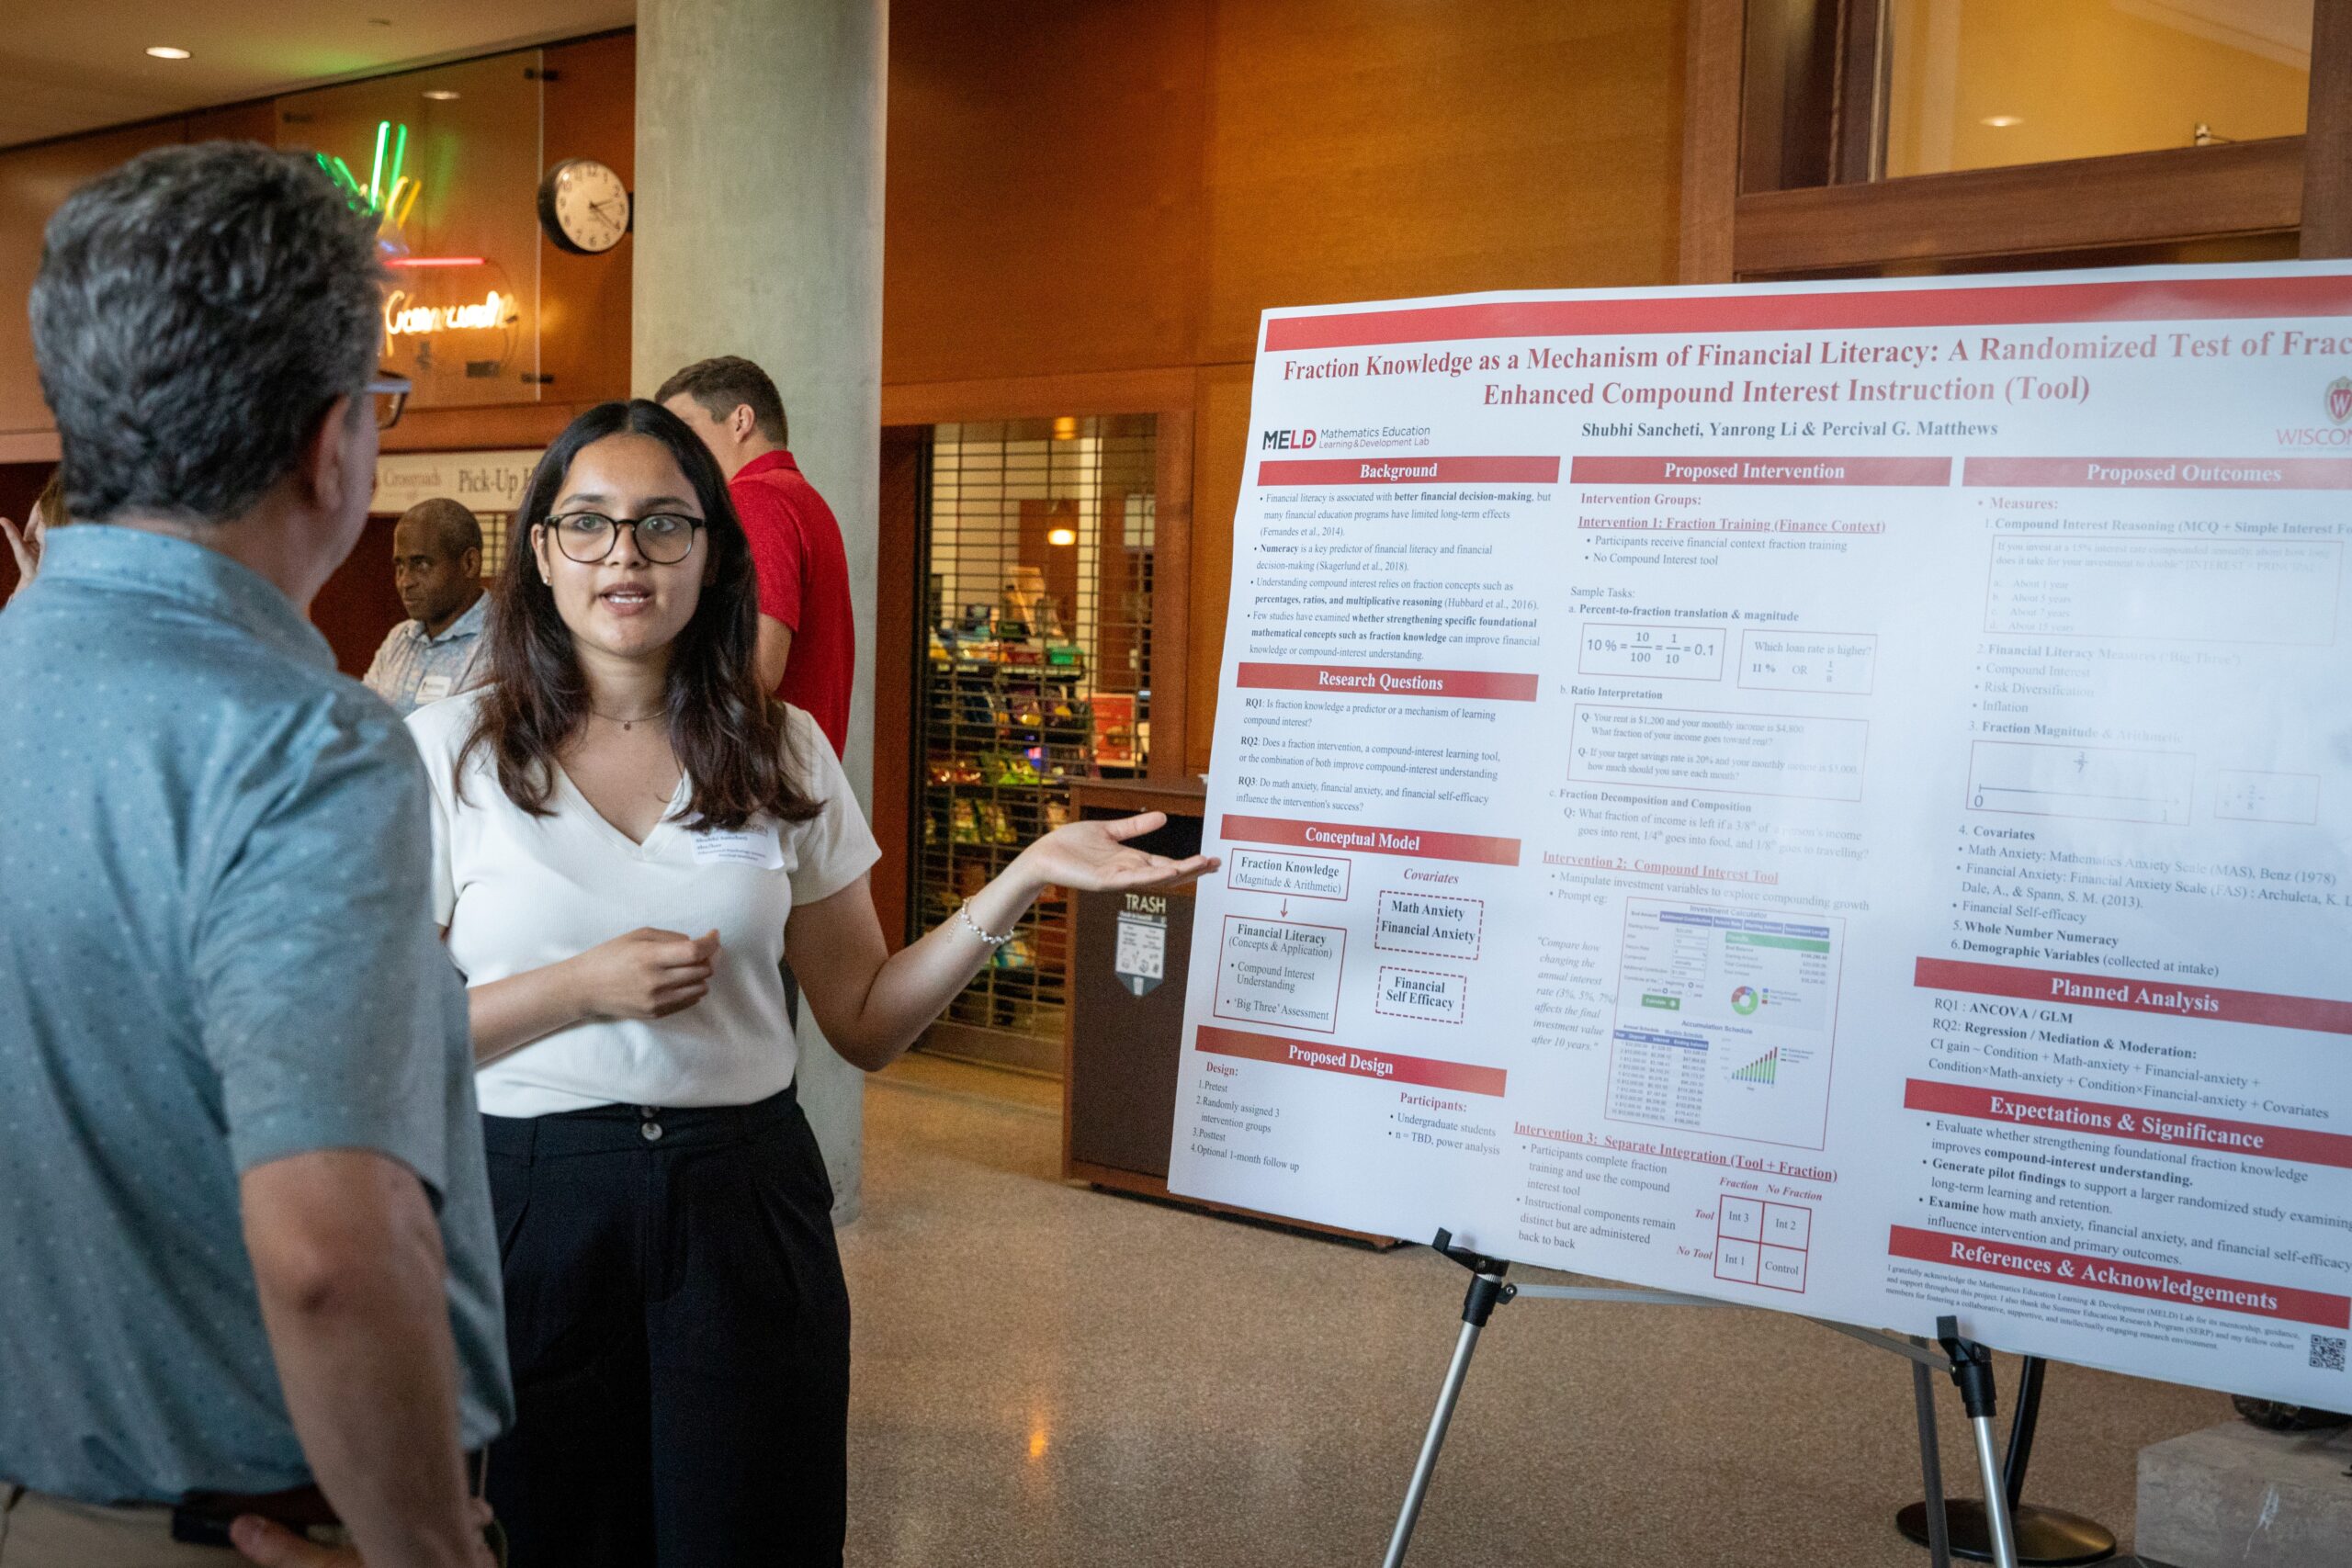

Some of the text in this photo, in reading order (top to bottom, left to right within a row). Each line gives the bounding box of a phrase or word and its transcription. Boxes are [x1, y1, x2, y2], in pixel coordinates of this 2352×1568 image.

[1283, 332, 2352, 379] Fraction Knowledge as a Mechanism of Financial Literacy: A Randomized Test of Frac
[1484, 377, 2089, 409] Enhanced Compound Interest Instruction (Tool)
[1262, 430, 1317, 450] MELD
[1320, 425, 1430, 439] Mathematics Education
[1581, 422, 1997, 438] Shubhi Sancheti, Yanrong Li & Percival G. Matthews
[1360, 464, 1438, 480] Background
[1664, 463, 1845, 481] Proposed Intervention
[2086, 464, 2282, 485] Proposed Outcomes
[458, 468, 519, 500] Pick-Up
[1266, 493, 1299, 502] Financial
[1300, 493, 1327, 503] literacy
[1336, 492, 1374, 502] associated
[1375, 492, 1393, 501] with
[1394, 492, 1419, 501] better
[1420, 491, 1457, 501] financial
[1458, 491, 1534, 502] decision-making,
[1537, 492, 1551, 502] but
[1581, 493, 1702, 508] Intervention Groups:
[1578, 515, 1648, 529] Intervention
[1667, 517, 1715, 530] Fraction
[1721, 518, 1770, 534] Training
[1774, 518, 1828, 533] (Finance
[1832, 519, 1885, 534] Context)
[1318, 671, 1443, 691] Research Questions
[1245, 698, 1265, 709] RQ1:
[1275, 699, 1303, 709] fraction
[1304, 701, 1345, 714] knowledge
[1351, 704, 1387, 714] predictor
[1405, 706, 1449, 716] mechanism
[1450, 708, 1462, 717] of
[1460, 708, 1496, 722] learning
[1306, 828, 1420, 850] Conceptual Model
[1241, 857, 1340, 878] Fraction Knowledge
[1403, 868, 1459, 884] Covariates
[1235, 874, 1283, 886] (Magnitude
[1294, 880, 1341, 895] Arithmetic)
[1125, 893, 1167, 914] TRASH
[1392, 900, 1464, 920] Math Anxiety
[1238, 924, 1325, 946] Financial Literacy
[1381, 920, 1476, 943] Financial Anxiety
[1964, 921, 2119, 948] Whole Number Numeracy
[1228, 937, 1269, 952] (Concepts
[1280, 943, 1332, 958] Application)
[1962, 941, 2219, 976] Demographic Variables (collected at intake)
[1238, 962, 1315, 980] Compound Interest
[1237, 975, 1295, 992] Understanding
[1395, 976, 1445, 993] Financial
[1385, 990, 1454, 1010] Self Efficacy
[2051, 978, 2219, 1011] Planned Analysis
[1281, 1006, 1329, 1020] Assessment
[1933, 1018, 1961, 1032] RQ2:
[1964, 1022, 2027, 1039] Regression
[2039, 1031, 2099, 1047] Mediation
[2103, 1038, 2114, 1050] &
[2119, 1041, 2197, 1058] Moderation:
[1206, 1062, 1238, 1077] Design:
[1288, 1045, 1394, 1076] Proposed Design
[1400, 1092, 1467, 1111] Participants:
[1990, 1096, 2264, 1149] Expectations & Significance
[1515, 1121, 1583, 1143] Intervention
[1586, 1132, 1598, 1145] 3:
[1605, 1135, 1657, 1155] Separate
[1660, 1144, 1726, 1165] Integration
[1731, 1154, 1764, 1171] (Tool
[1780, 1161, 1838, 1183] Fraction)
[1719, 1177, 1758, 1190] Fraction
[1766, 1184, 1823, 1201] No Fraction
[1932, 1158, 1985, 1175] Generate
[1987, 1168, 2015, 1179] pilot
[2018, 1170, 2066, 1189] findings
[2070, 1179, 2081, 1189] to
[2084, 1183, 2127, 1196] support
[2141, 1188, 2176, 1204] larger
[2177, 1197, 2249, 1213] randomized
[2253, 1207, 2286, 1221] study
[1695, 1209, 1715, 1220] Tool
[1728, 1211, 1741, 1221] Int
[1776, 1218, 1788, 1229] Int
[1677, 1246, 1713, 1260] No Tool
[1724, 1254, 1737, 1264] Int
[1765, 1261, 1799, 1275] Control
[1951, 1242, 2278, 1310] References & Acknowledgements
